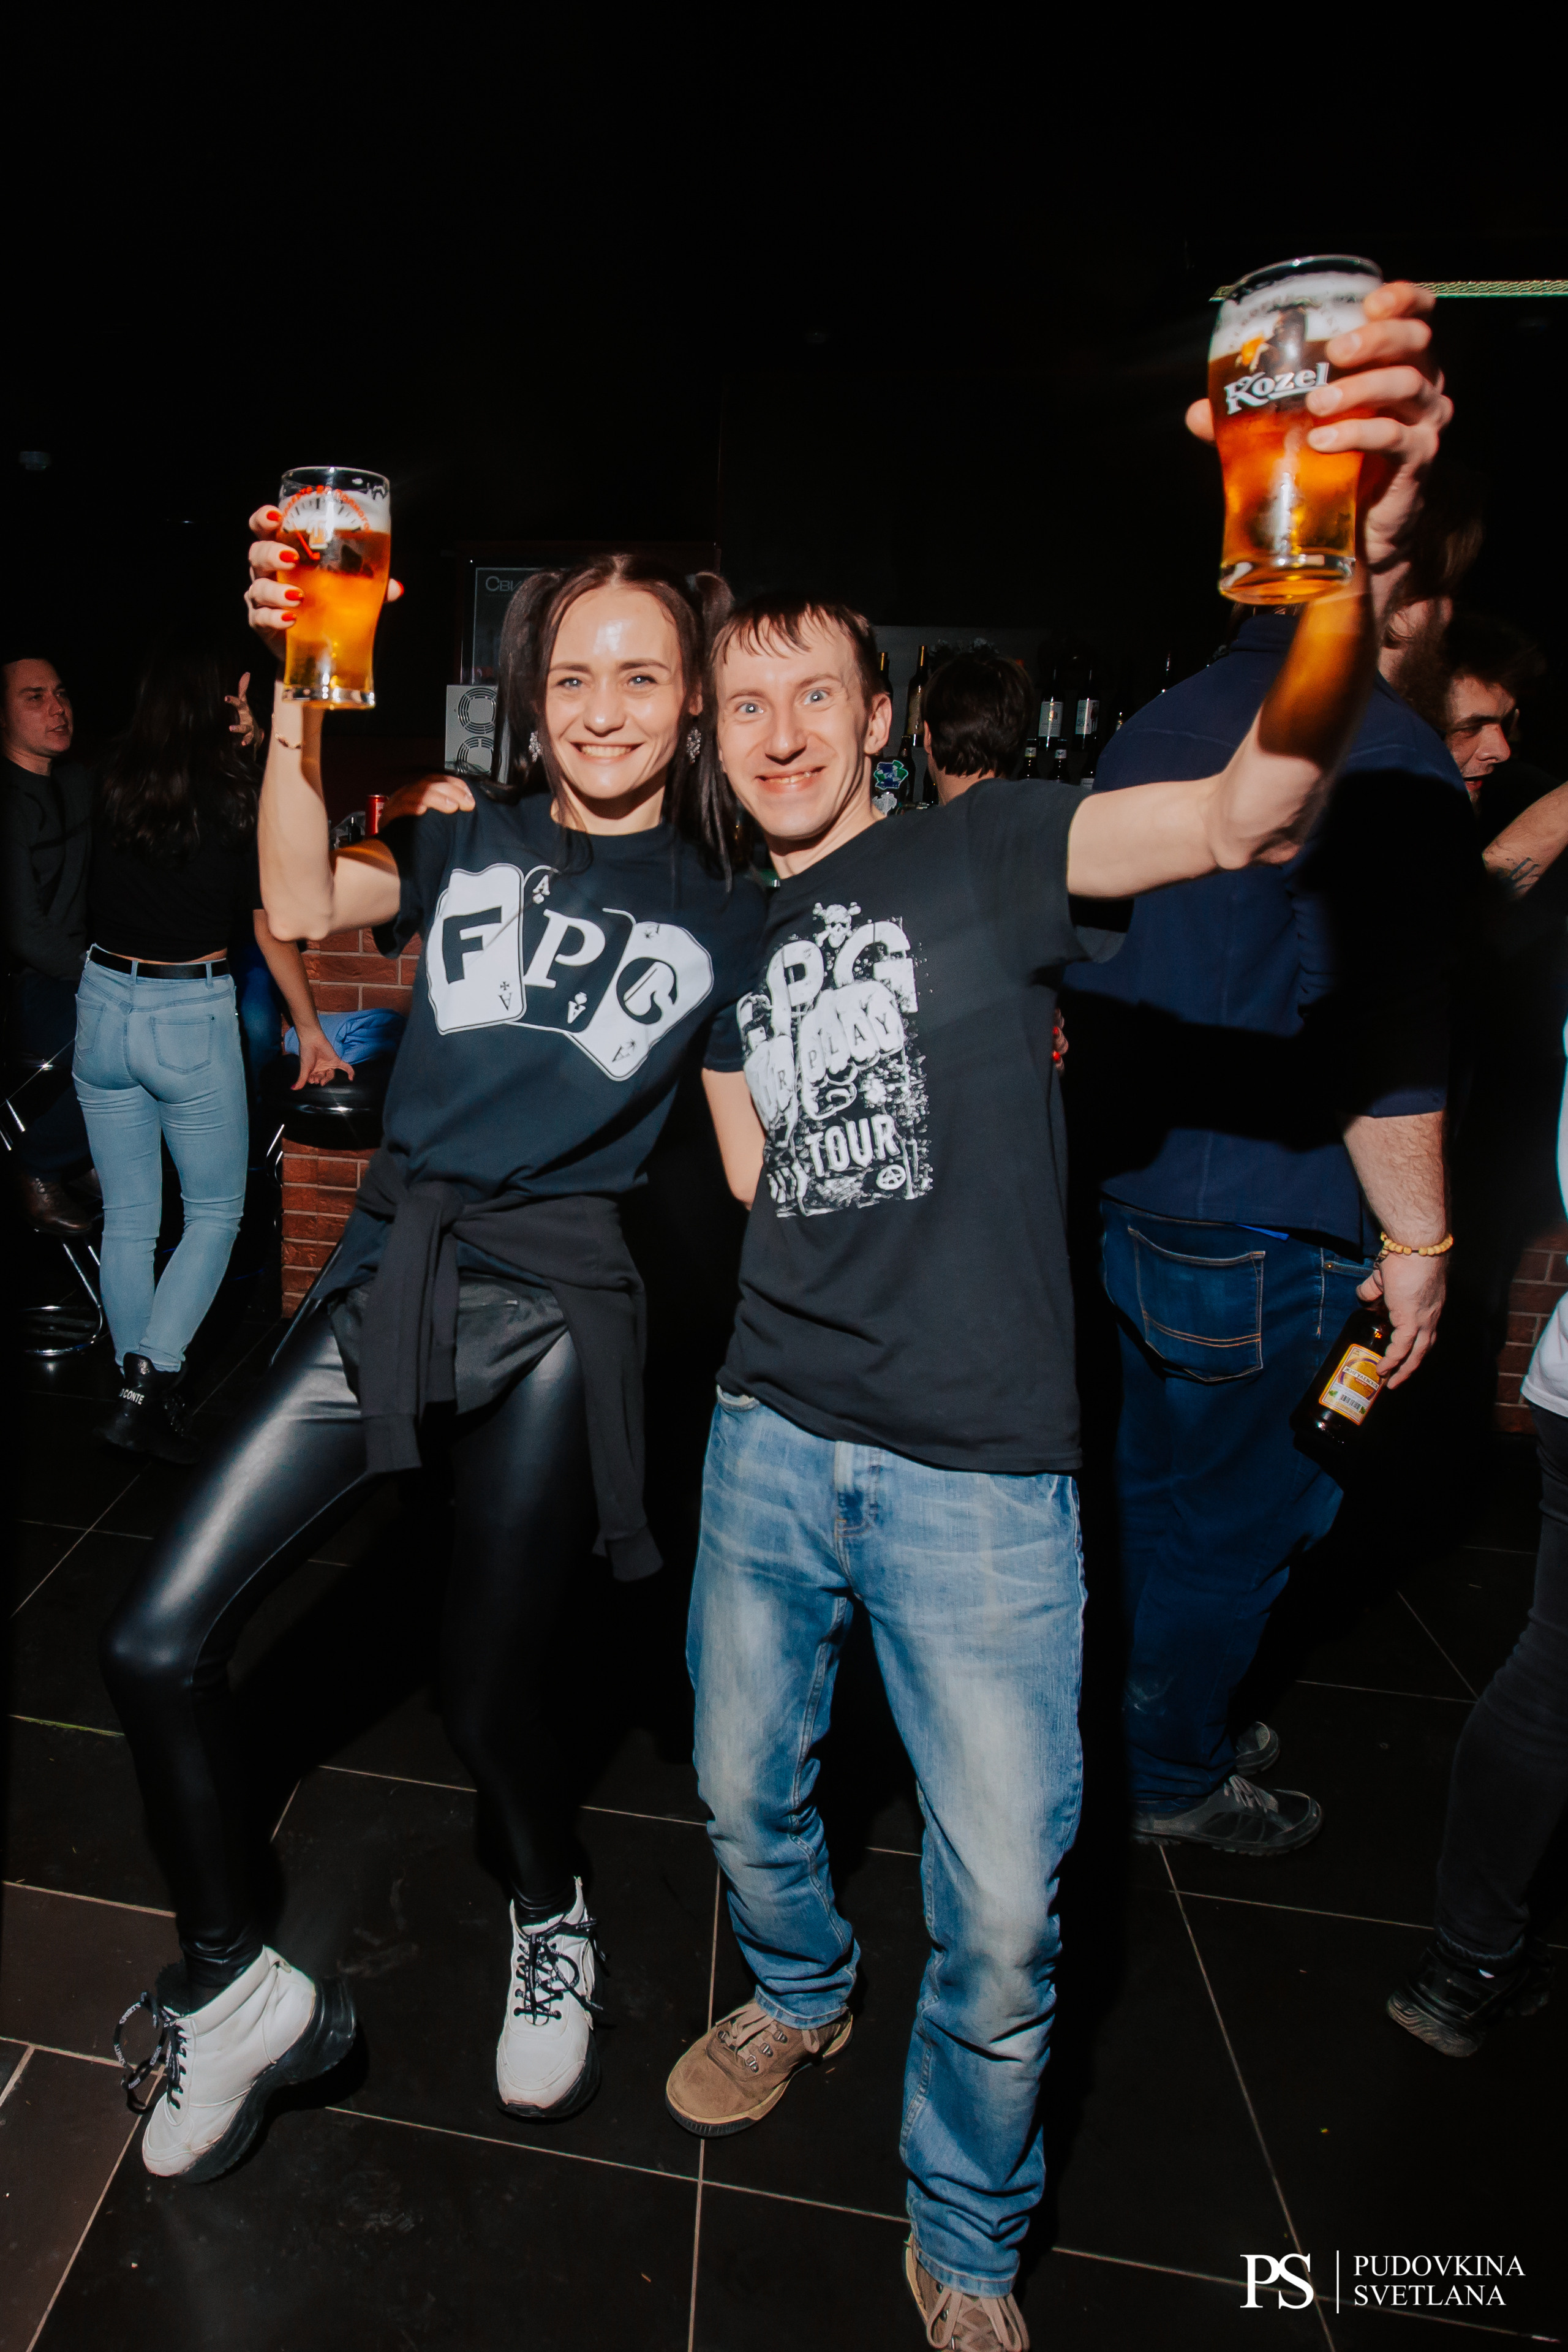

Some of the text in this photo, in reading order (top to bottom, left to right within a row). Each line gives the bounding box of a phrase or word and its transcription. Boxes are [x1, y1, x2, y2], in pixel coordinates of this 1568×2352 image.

[1224, 362, 1329, 415] Kozel
[807, 1012, 894, 1070] PLAY
[805, 1113, 901, 1177] TOUR
